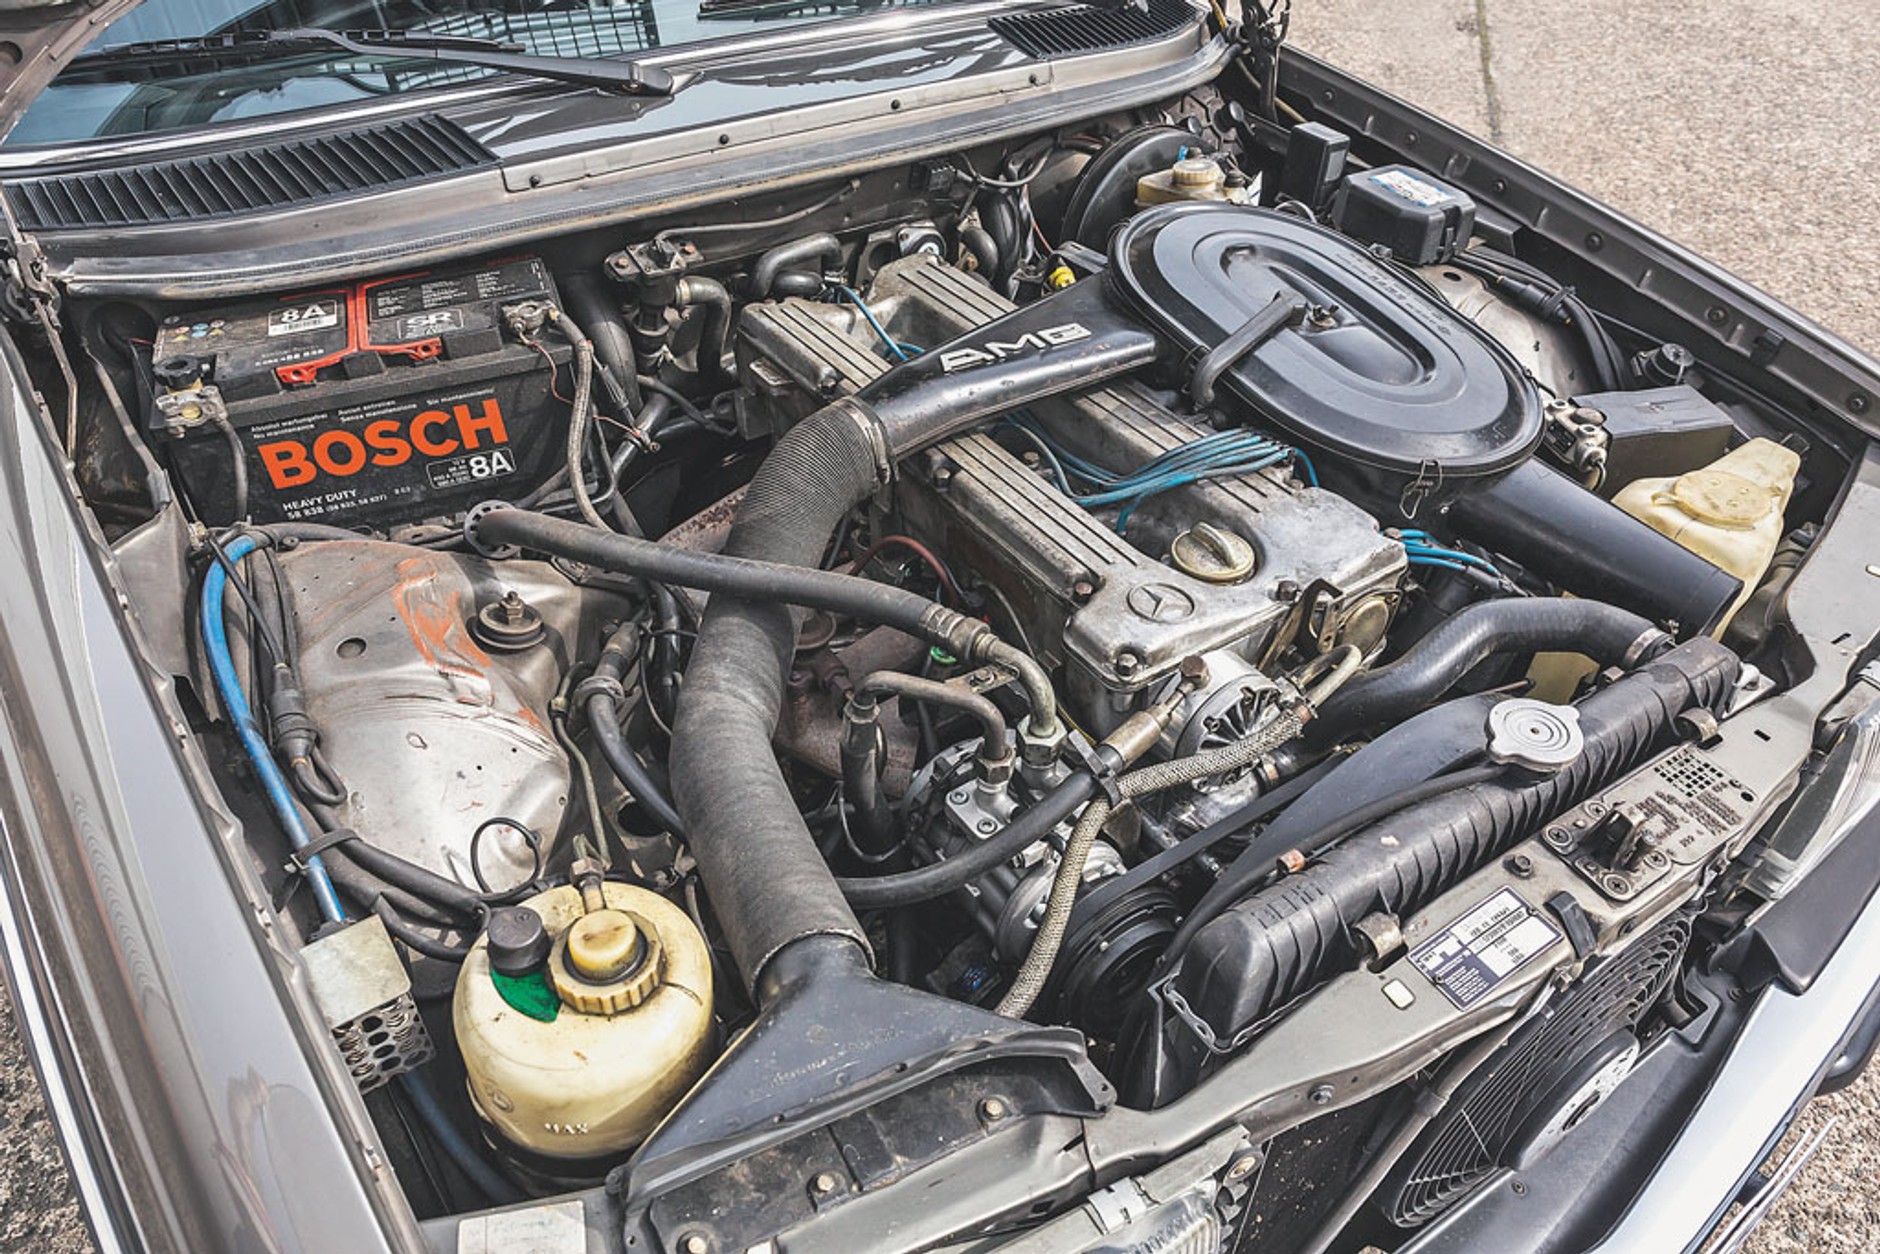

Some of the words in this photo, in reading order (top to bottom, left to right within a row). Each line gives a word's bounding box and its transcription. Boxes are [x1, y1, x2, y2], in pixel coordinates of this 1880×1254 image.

[280, 304, 327, 323] 8A
[940, 322, 1092, 373] AMG
[257, 397, 509, 490] BOSCH
[469, 451, 514, 478] 8A
[282, 496, 322, 512] HEAVY
[325, 488, 358, 503] DUTY
